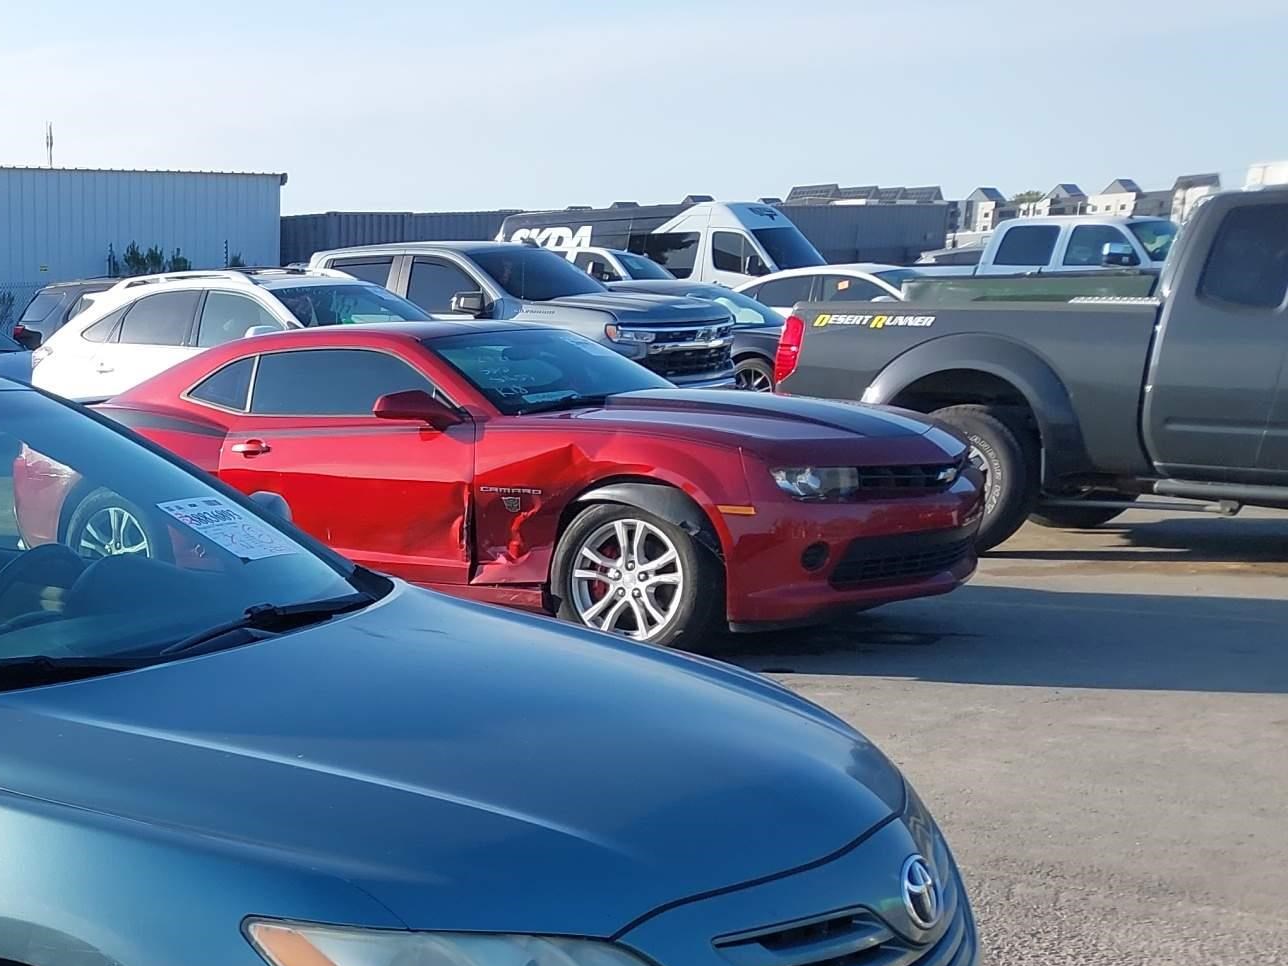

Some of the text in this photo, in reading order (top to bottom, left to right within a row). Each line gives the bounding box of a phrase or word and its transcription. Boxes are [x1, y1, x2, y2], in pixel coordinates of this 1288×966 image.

[813, 314, 936, 329] DESERT RUNNER
[480, 486, 542, 495] CAMARO
